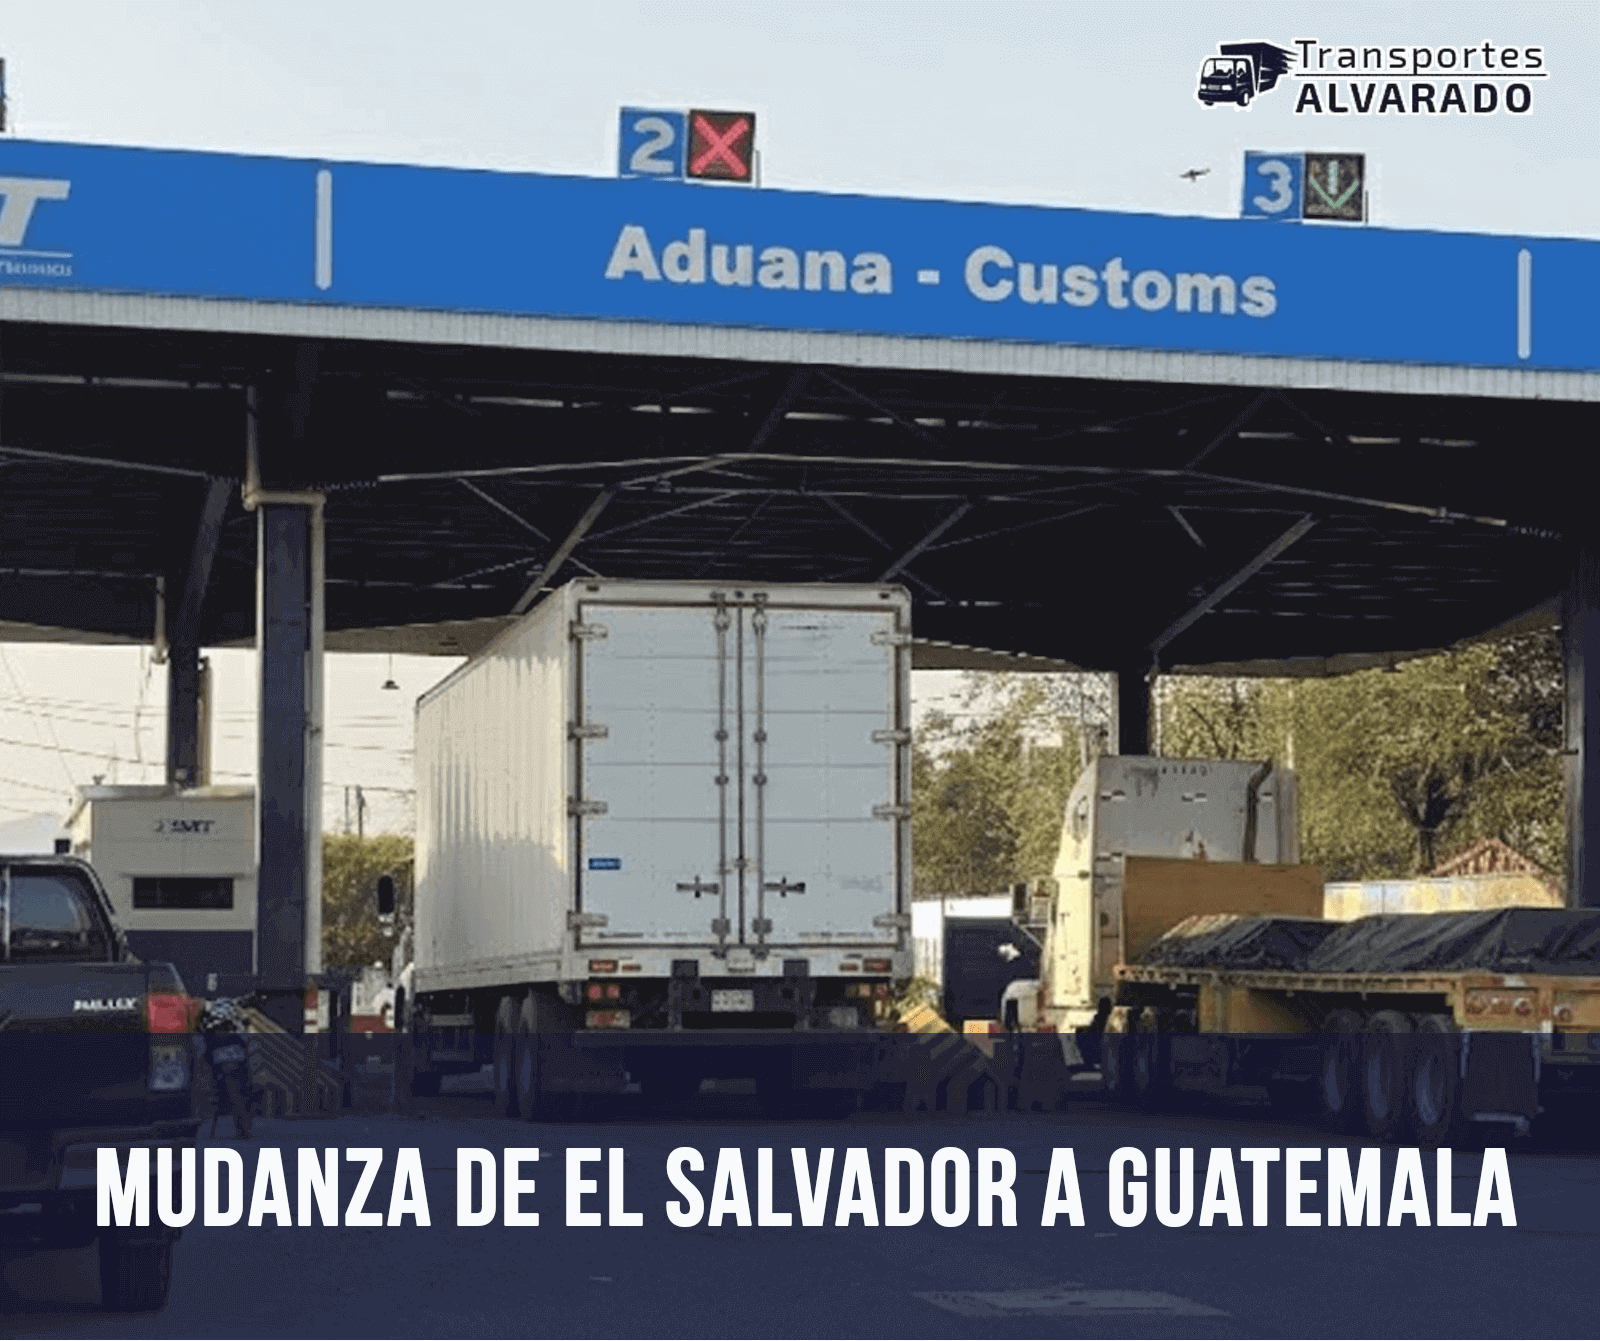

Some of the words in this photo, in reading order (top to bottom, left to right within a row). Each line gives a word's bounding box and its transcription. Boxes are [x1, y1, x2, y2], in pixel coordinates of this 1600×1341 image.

[631, 117, 676, 174] 2
[1253, 160, 1294, 213] 3
[605, 224, 892, 295] Aduana
[965, 245, 1278, 318] Customs
